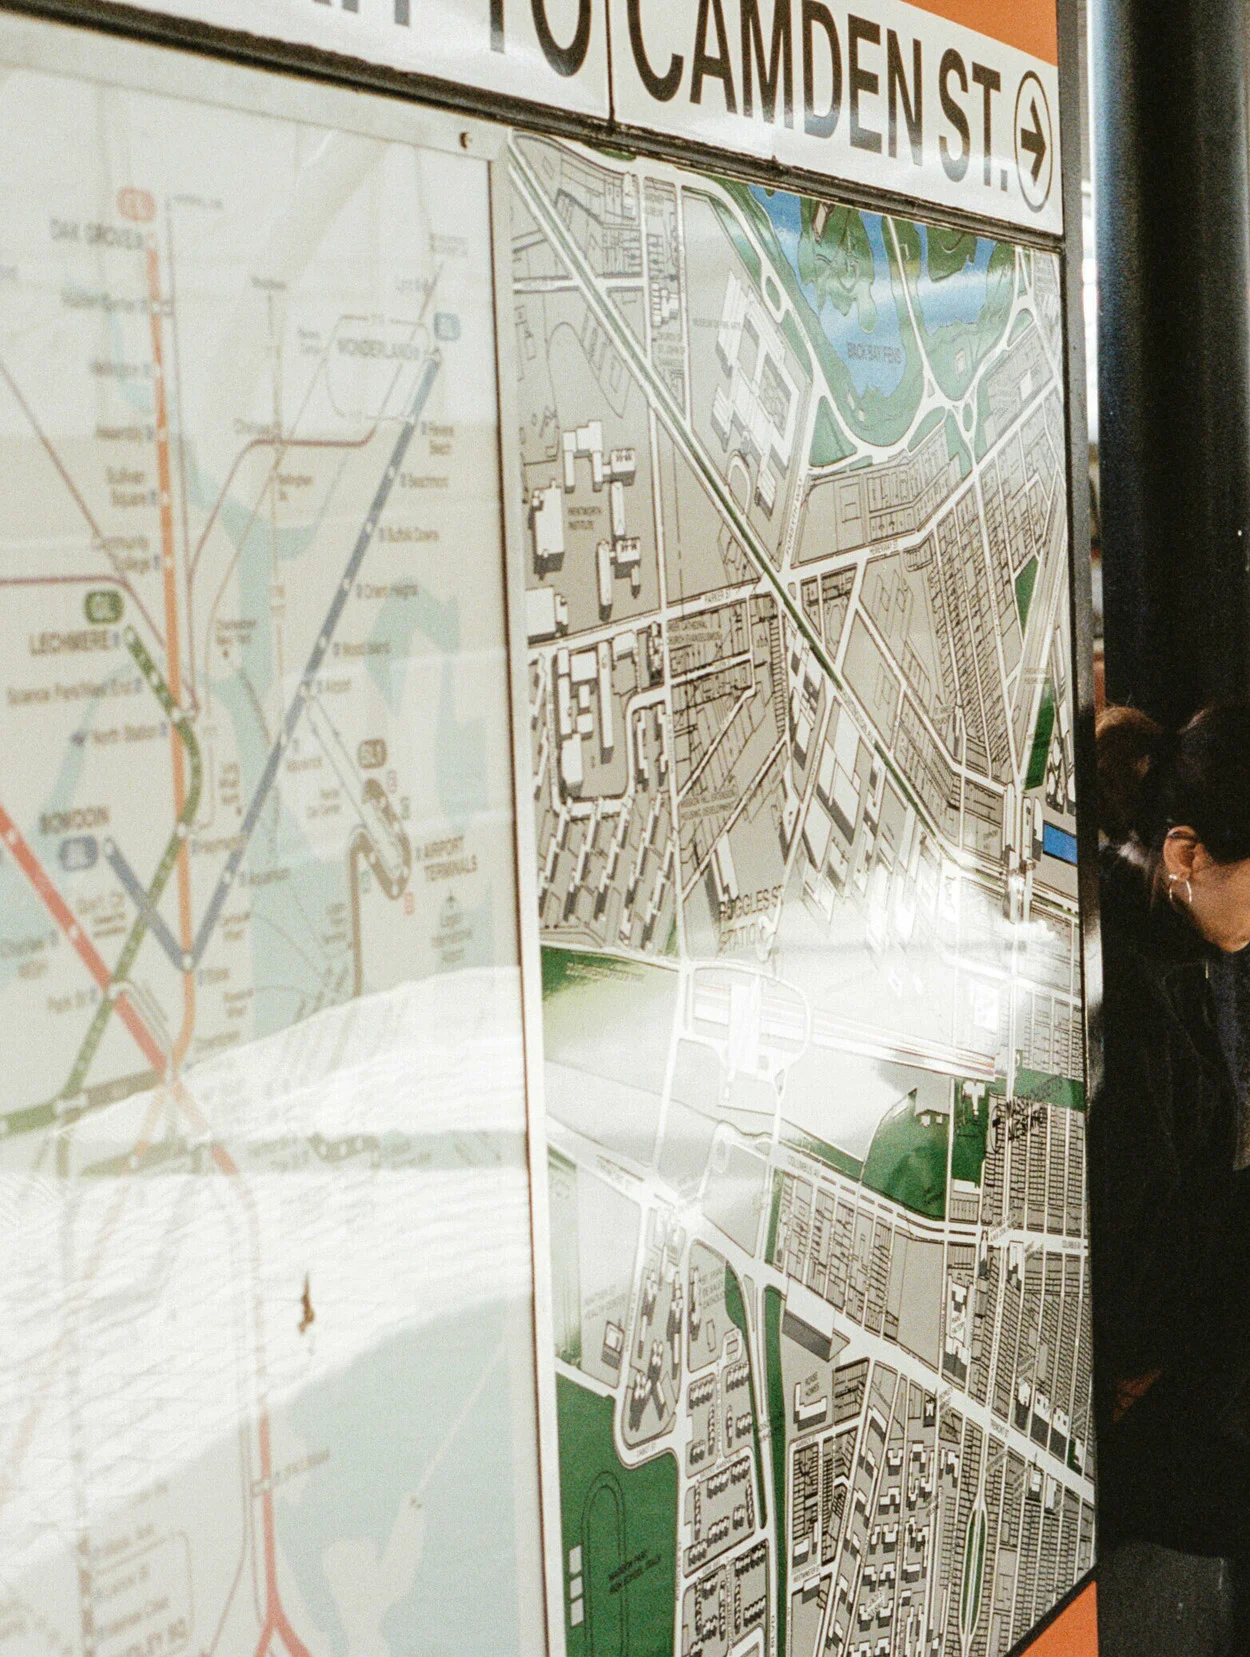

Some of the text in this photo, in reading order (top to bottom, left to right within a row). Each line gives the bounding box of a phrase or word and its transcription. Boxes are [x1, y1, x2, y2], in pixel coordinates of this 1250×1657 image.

[625, 0, 923, 167] CAMDEN
[938, 47, 1009, 193] ST.
[720, 888, 769, 921] RUGGLES
